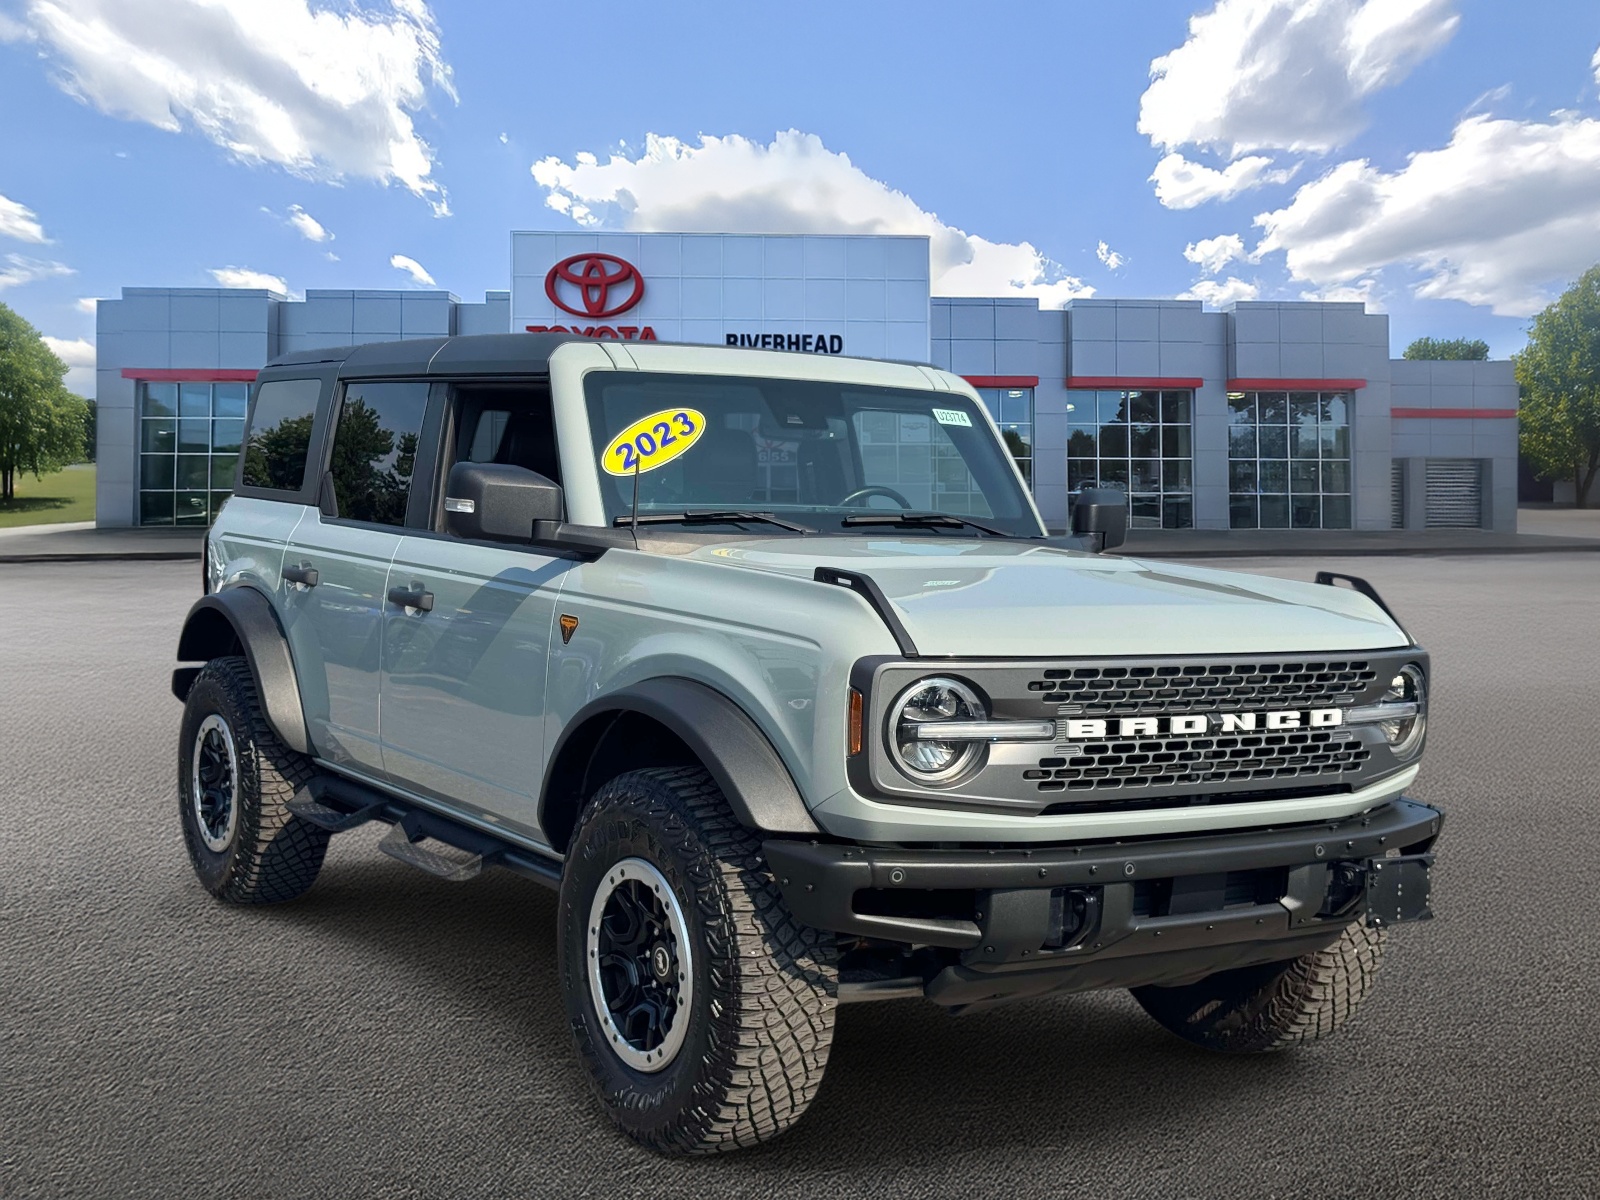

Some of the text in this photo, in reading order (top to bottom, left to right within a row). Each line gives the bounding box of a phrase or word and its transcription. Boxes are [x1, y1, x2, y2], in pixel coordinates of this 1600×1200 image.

[726, 333, 843, 354] RIVERHEAD
[615, 412, 695, 471] 2023
[1066, 708, 1343, 739] BRONCO
